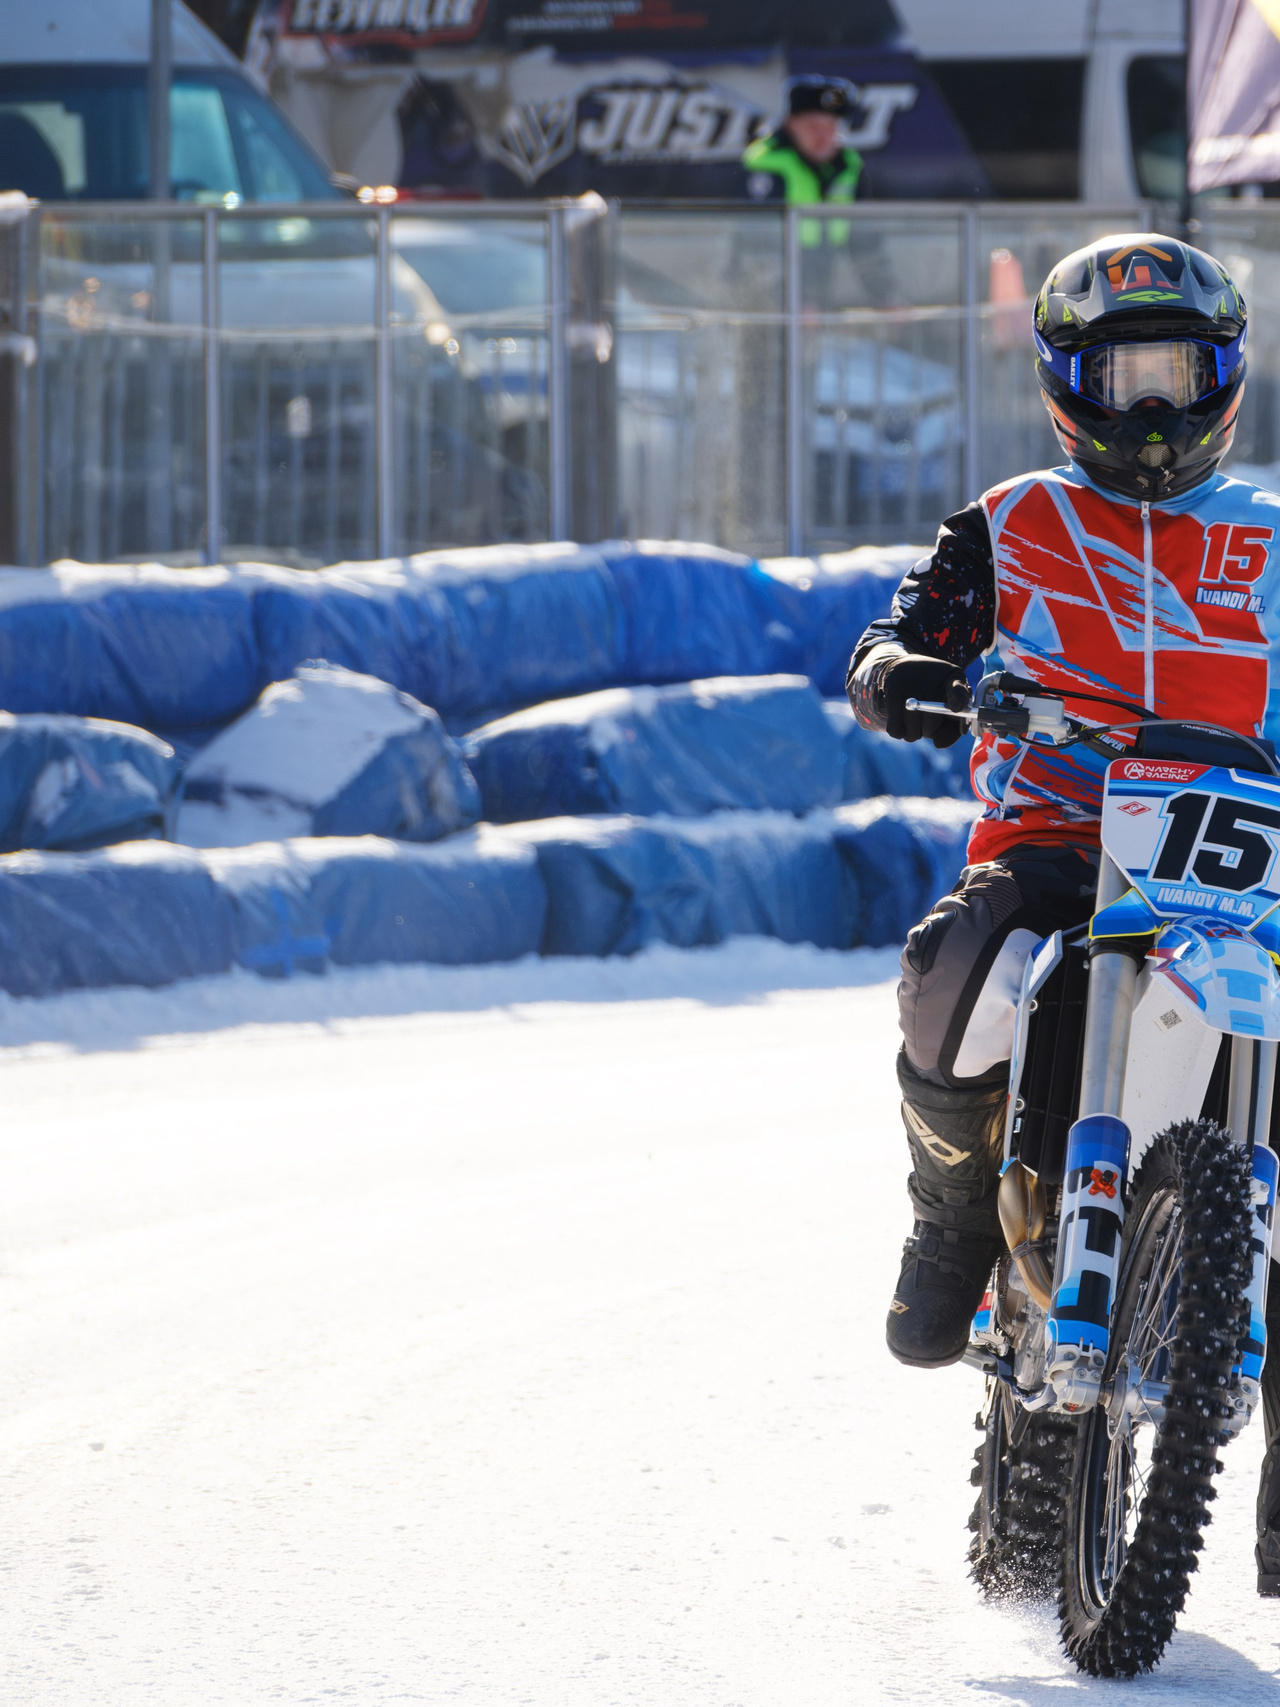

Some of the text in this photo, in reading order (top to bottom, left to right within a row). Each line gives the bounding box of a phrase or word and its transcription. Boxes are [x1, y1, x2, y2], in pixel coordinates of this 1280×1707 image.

[1200, 521, 1275, 584] 15
[1196, 586, 1265, 613] IVANOV M.
[1146, 772, 1189, 781] RACING
[1156, 887, 1257, 919] IVANOV M.M.
